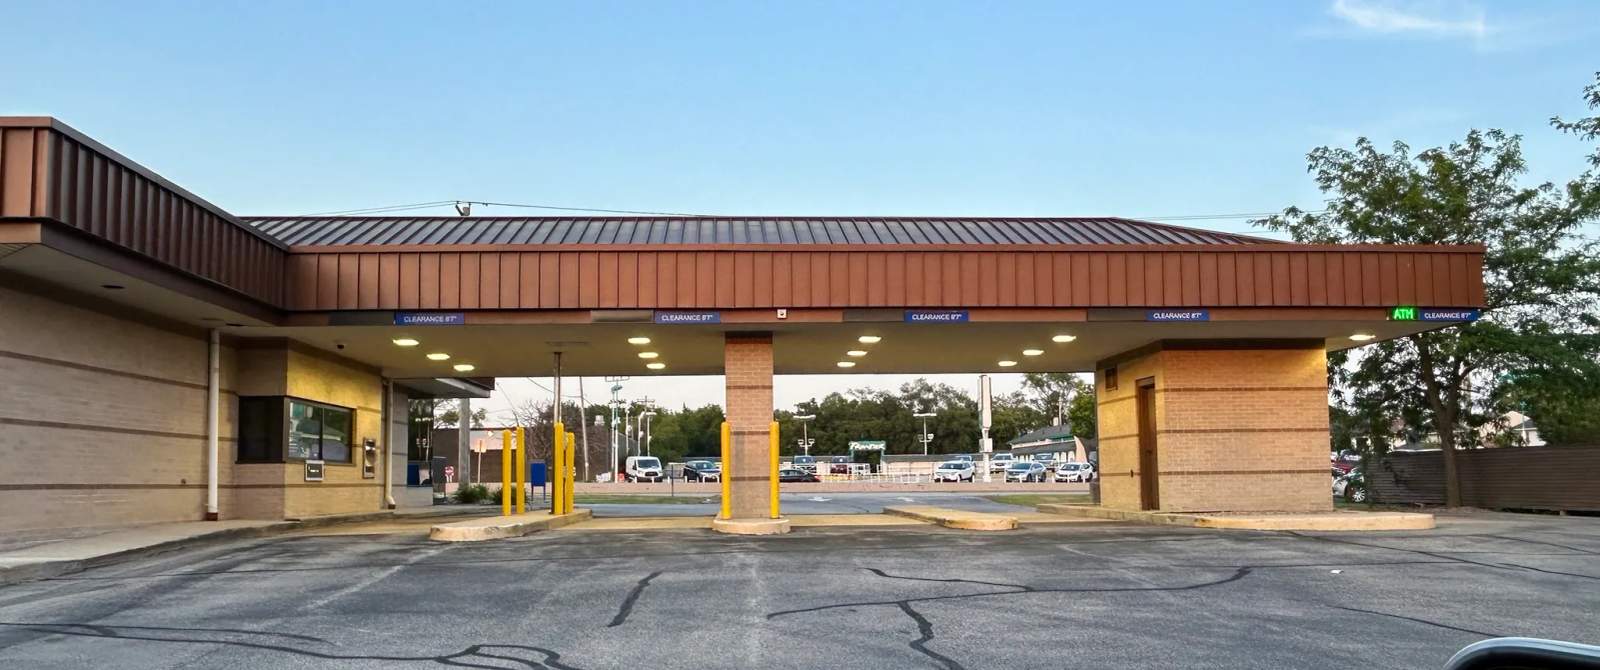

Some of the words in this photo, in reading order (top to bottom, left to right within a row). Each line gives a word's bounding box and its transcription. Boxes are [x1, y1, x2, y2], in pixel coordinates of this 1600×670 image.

[911, 313, 950, 321] CLEARANCE
[1393, 308, 1414, 320] ATM
[403, 315, 444, 323] CLEARANCE
